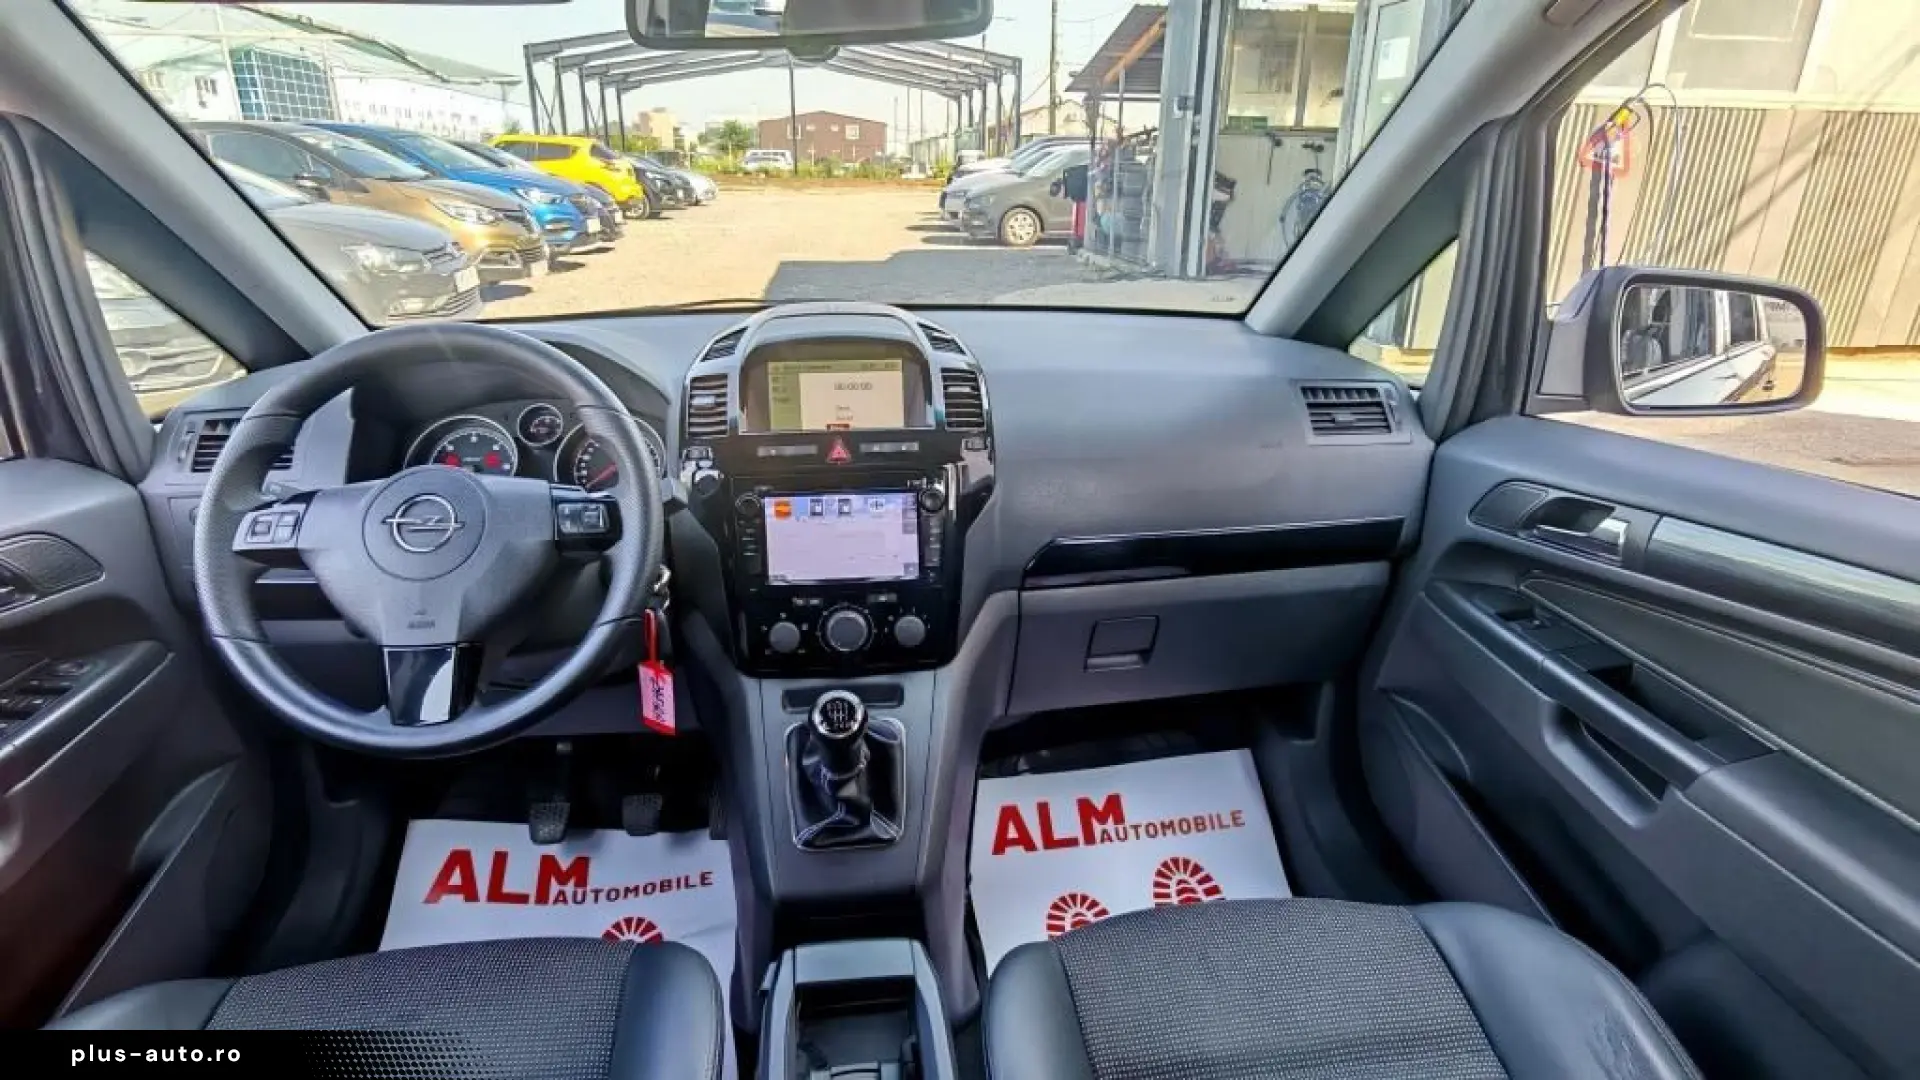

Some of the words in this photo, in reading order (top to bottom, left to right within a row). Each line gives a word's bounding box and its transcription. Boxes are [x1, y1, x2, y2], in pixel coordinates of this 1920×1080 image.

[991, 793, 1126, 856] ALM
[1100, 809, 1246, 845] AUTOMOBILE
[423, 848, 591, 905] ALM
[551, 871, 714, 906] AUTOMOBILE
